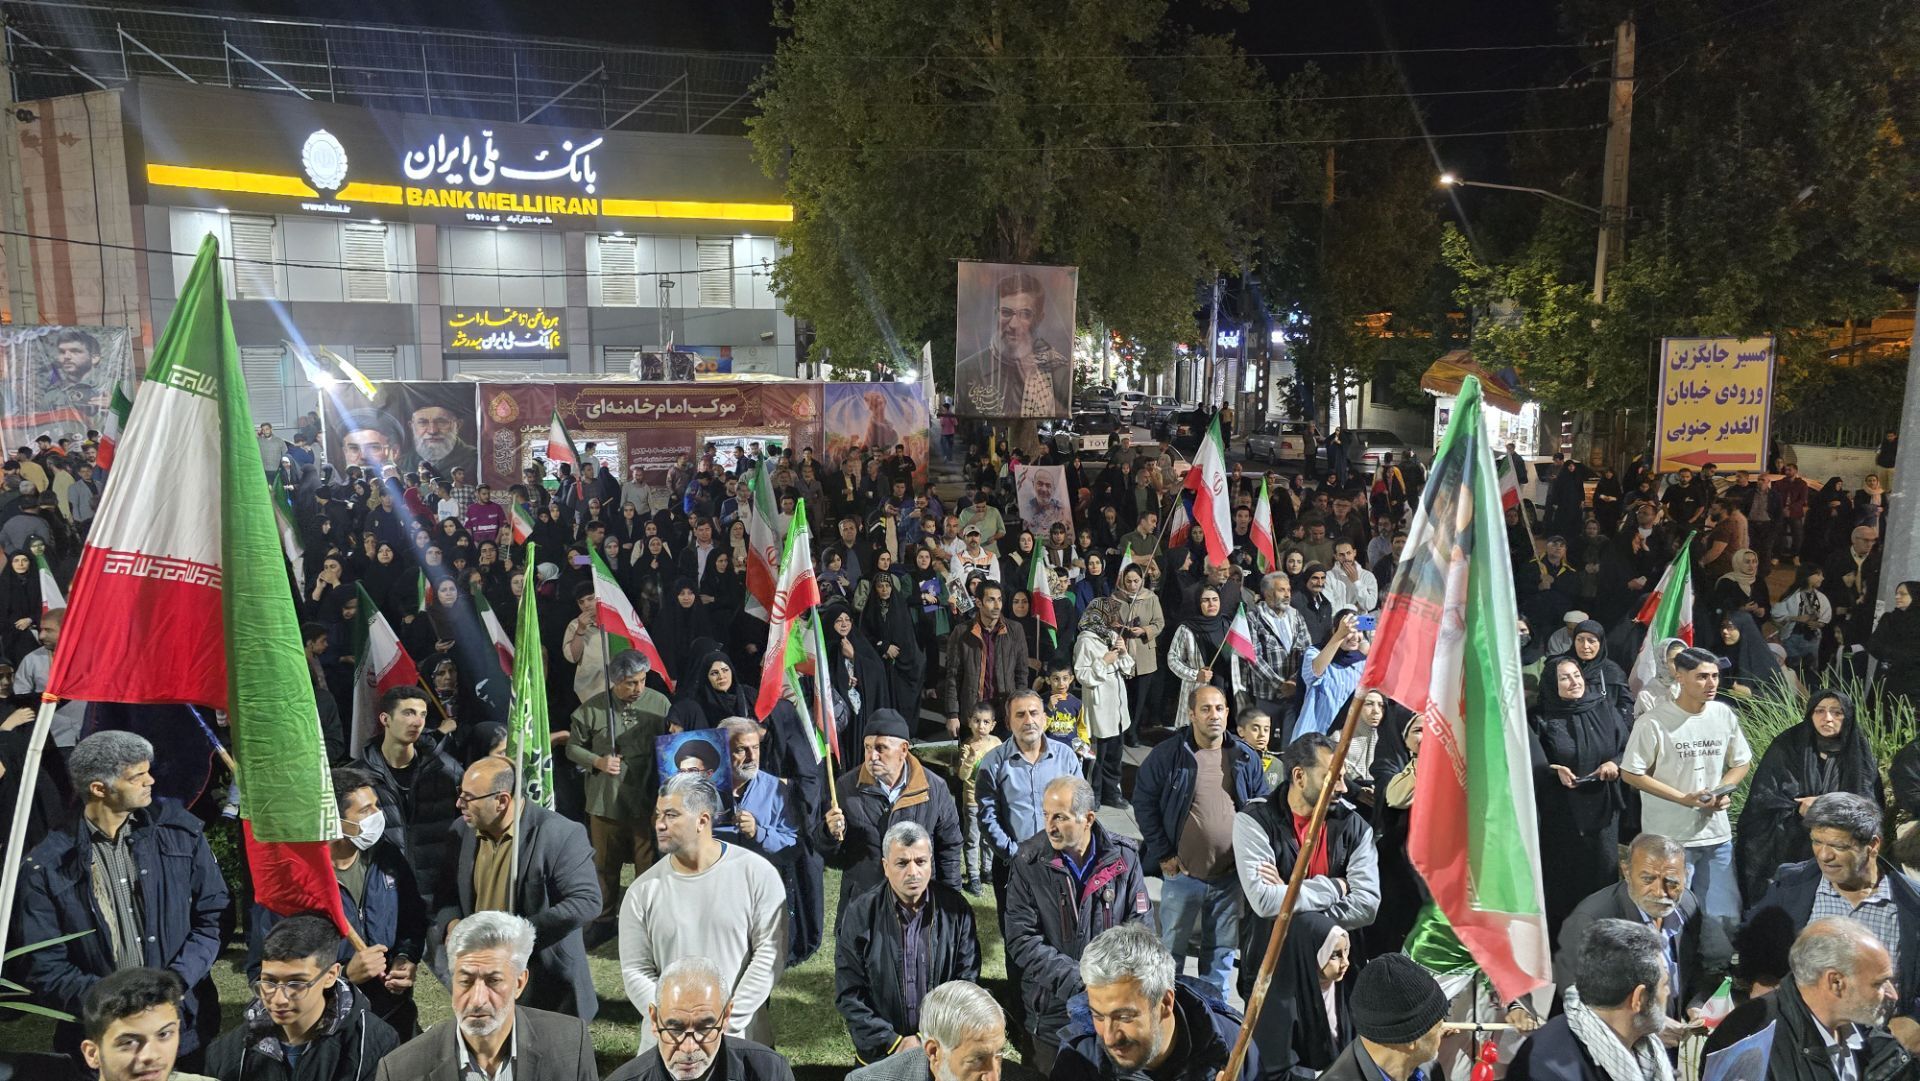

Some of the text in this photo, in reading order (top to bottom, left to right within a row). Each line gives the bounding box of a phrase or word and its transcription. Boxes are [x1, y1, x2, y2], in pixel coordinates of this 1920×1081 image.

[403, 133, 471, 185] ایران
[500, 137, 603, 194] بانک
[405, 187, 598, 216] BANK MELLI IRAN
[514, 329, 553, 350] بانک
[1670, 343, 1767, 370] مسیر جایگزین
[1666, 380, 1764, 405] ورودی خیابان
[655, 398, 688, 420] امام
[687, 398, 737, 417] موکب
[1666, 414, 1759, 442] الغدیر جنوبی
[1675, 742, 1691, 750] OR
[1677, 750, 1697, 759] THE
